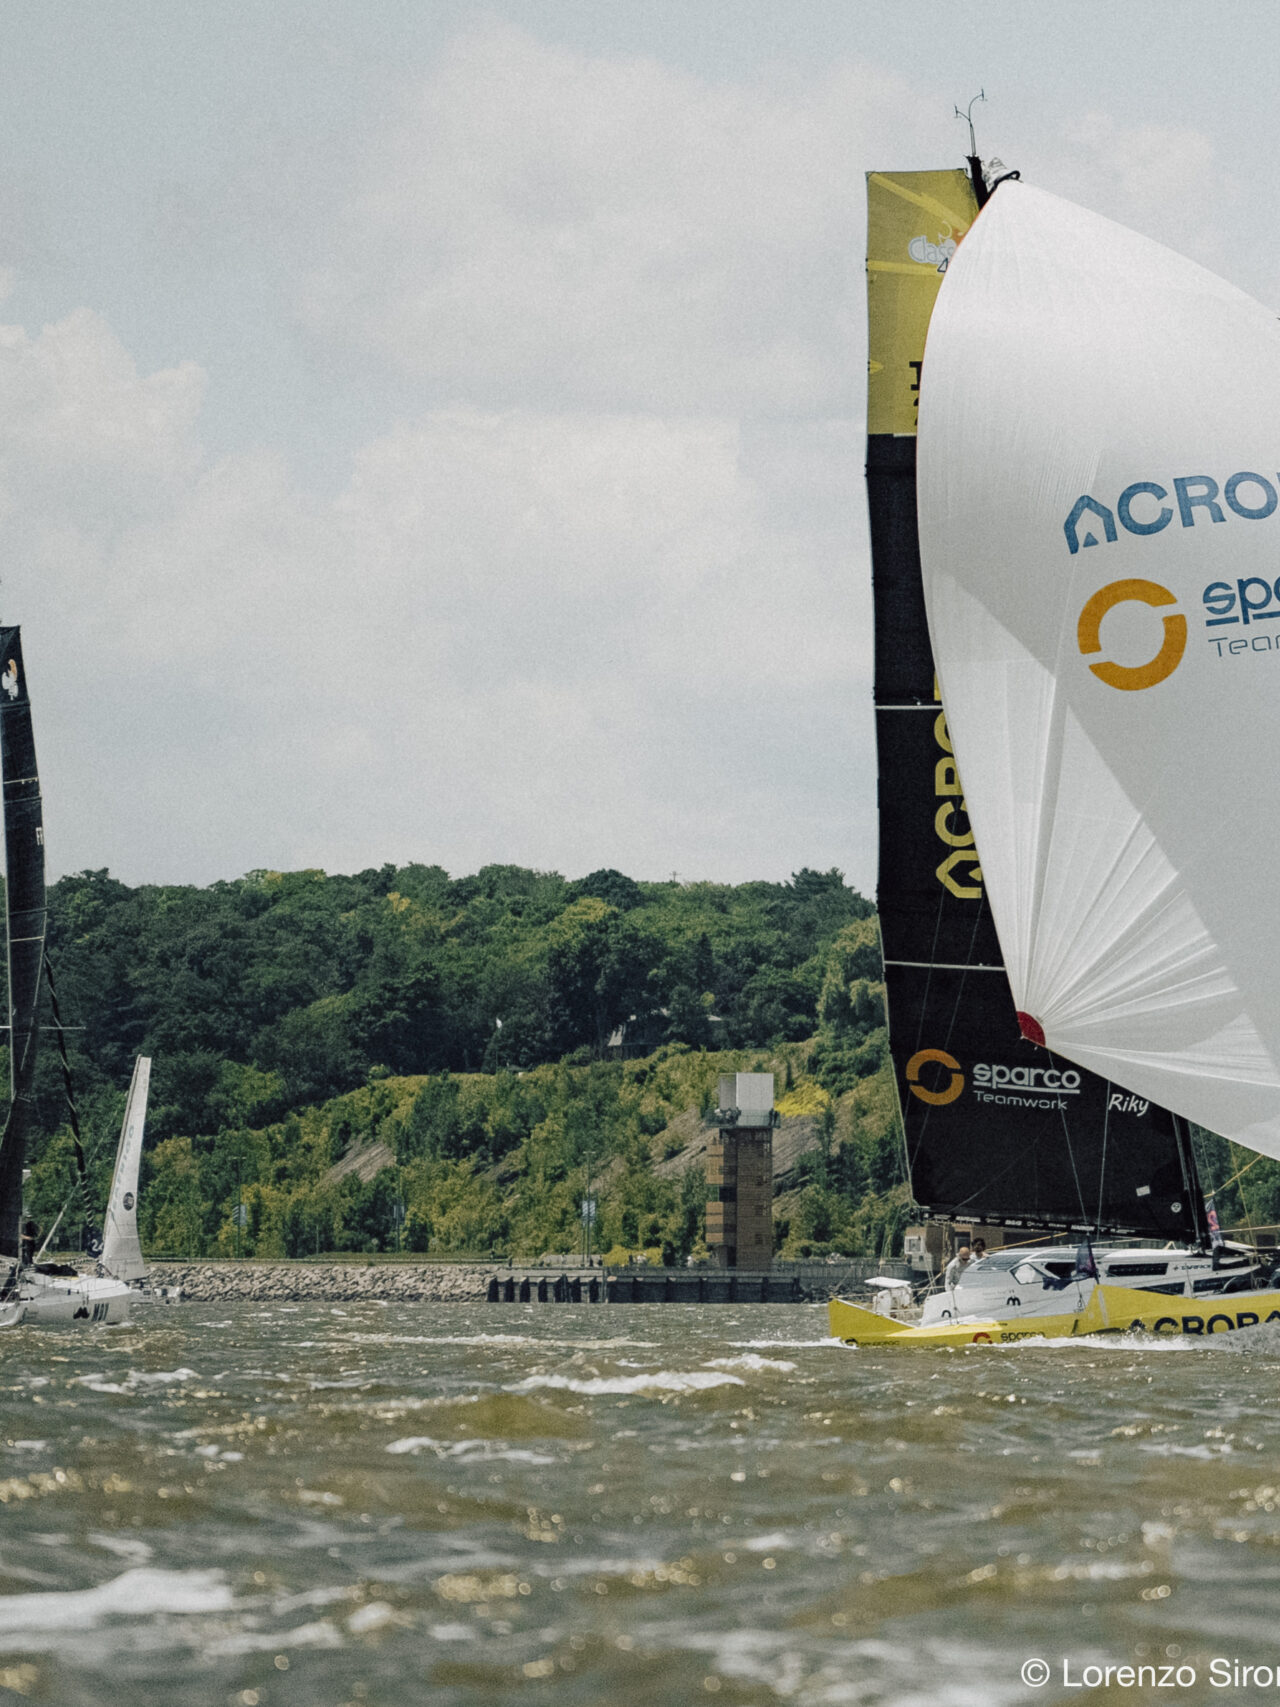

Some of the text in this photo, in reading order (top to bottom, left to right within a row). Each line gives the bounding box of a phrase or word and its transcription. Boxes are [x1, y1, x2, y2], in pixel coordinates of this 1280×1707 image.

[972, 1063, 1080, 1090] sparco
[973, 1090, 1068, 1110] Teamwork
[1109, 1093, 1149, 1117] Riky
